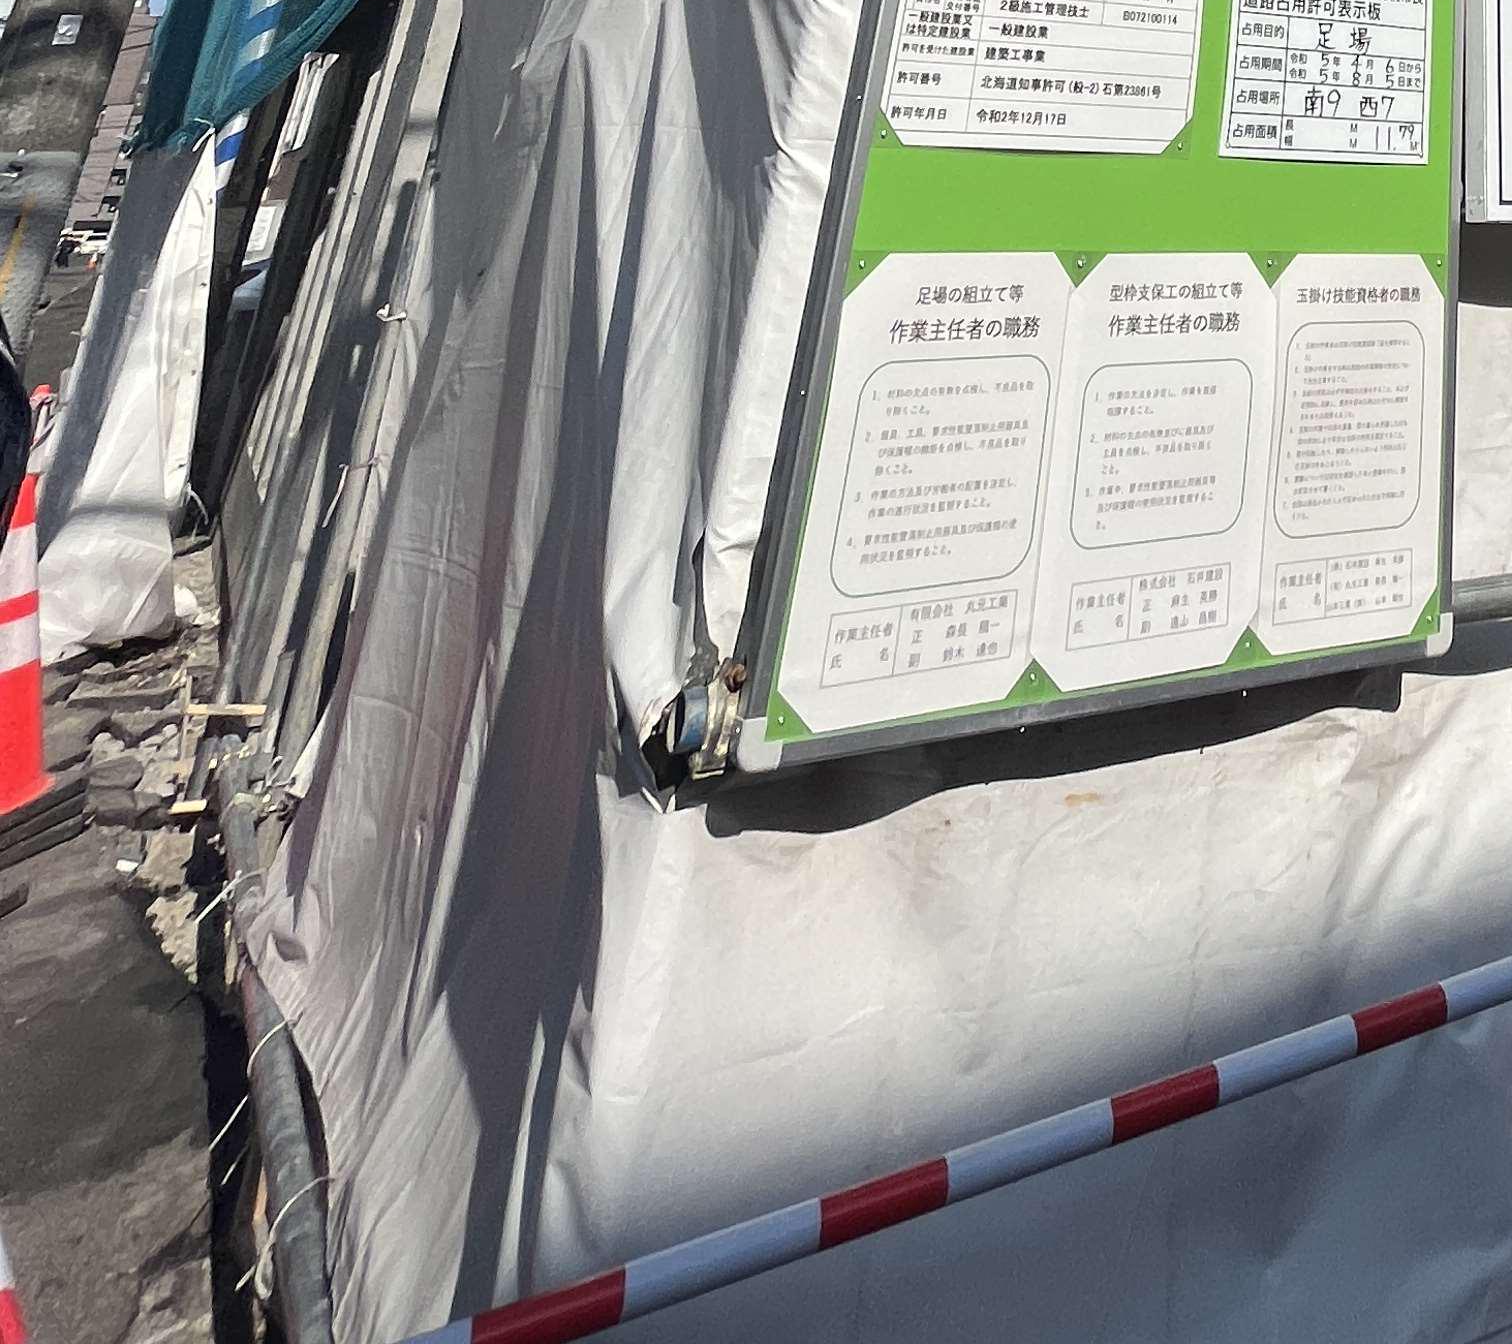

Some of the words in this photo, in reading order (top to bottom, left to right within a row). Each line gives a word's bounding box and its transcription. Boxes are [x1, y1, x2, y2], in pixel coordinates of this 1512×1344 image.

[999, 0, 1091, 20] 2級施工管理技士
[988, 23, 1050, 40] 一般建設業
[1241, 23, 1285, 39] 占用目的
[1316, 22, 1372, 56] 足場
[984, 46, 1047, 63] 建築工事業
[1239, 55, 1283, 72] 占用期間
[896, 70, 942, 86] 許可番号
[1236, 89, 1281, 106] 占用場所
[890, 105, 948, 121] 許可年月日
[975, 107, 1068, 127] 令和2年12月17日
[1232, 123, 1278, 140] 占用面積
[915, 283, 1026, 306] 足場の組立て等
[1109, 280, 1244, 302] 型枠支保工の組立て等
[1296, 286, 1422, 305] 玉掛け技能資格者の職務
[889, 315, 1041, 345] 作業主任者の職務
[1108, 311, 1241, 338] 作業主任者の職務
[1138, 574, 1177, 592] 株式会社
[909, 603, 955, 622] 有限会社
[834, 621, 894, 644] 作業主任者
